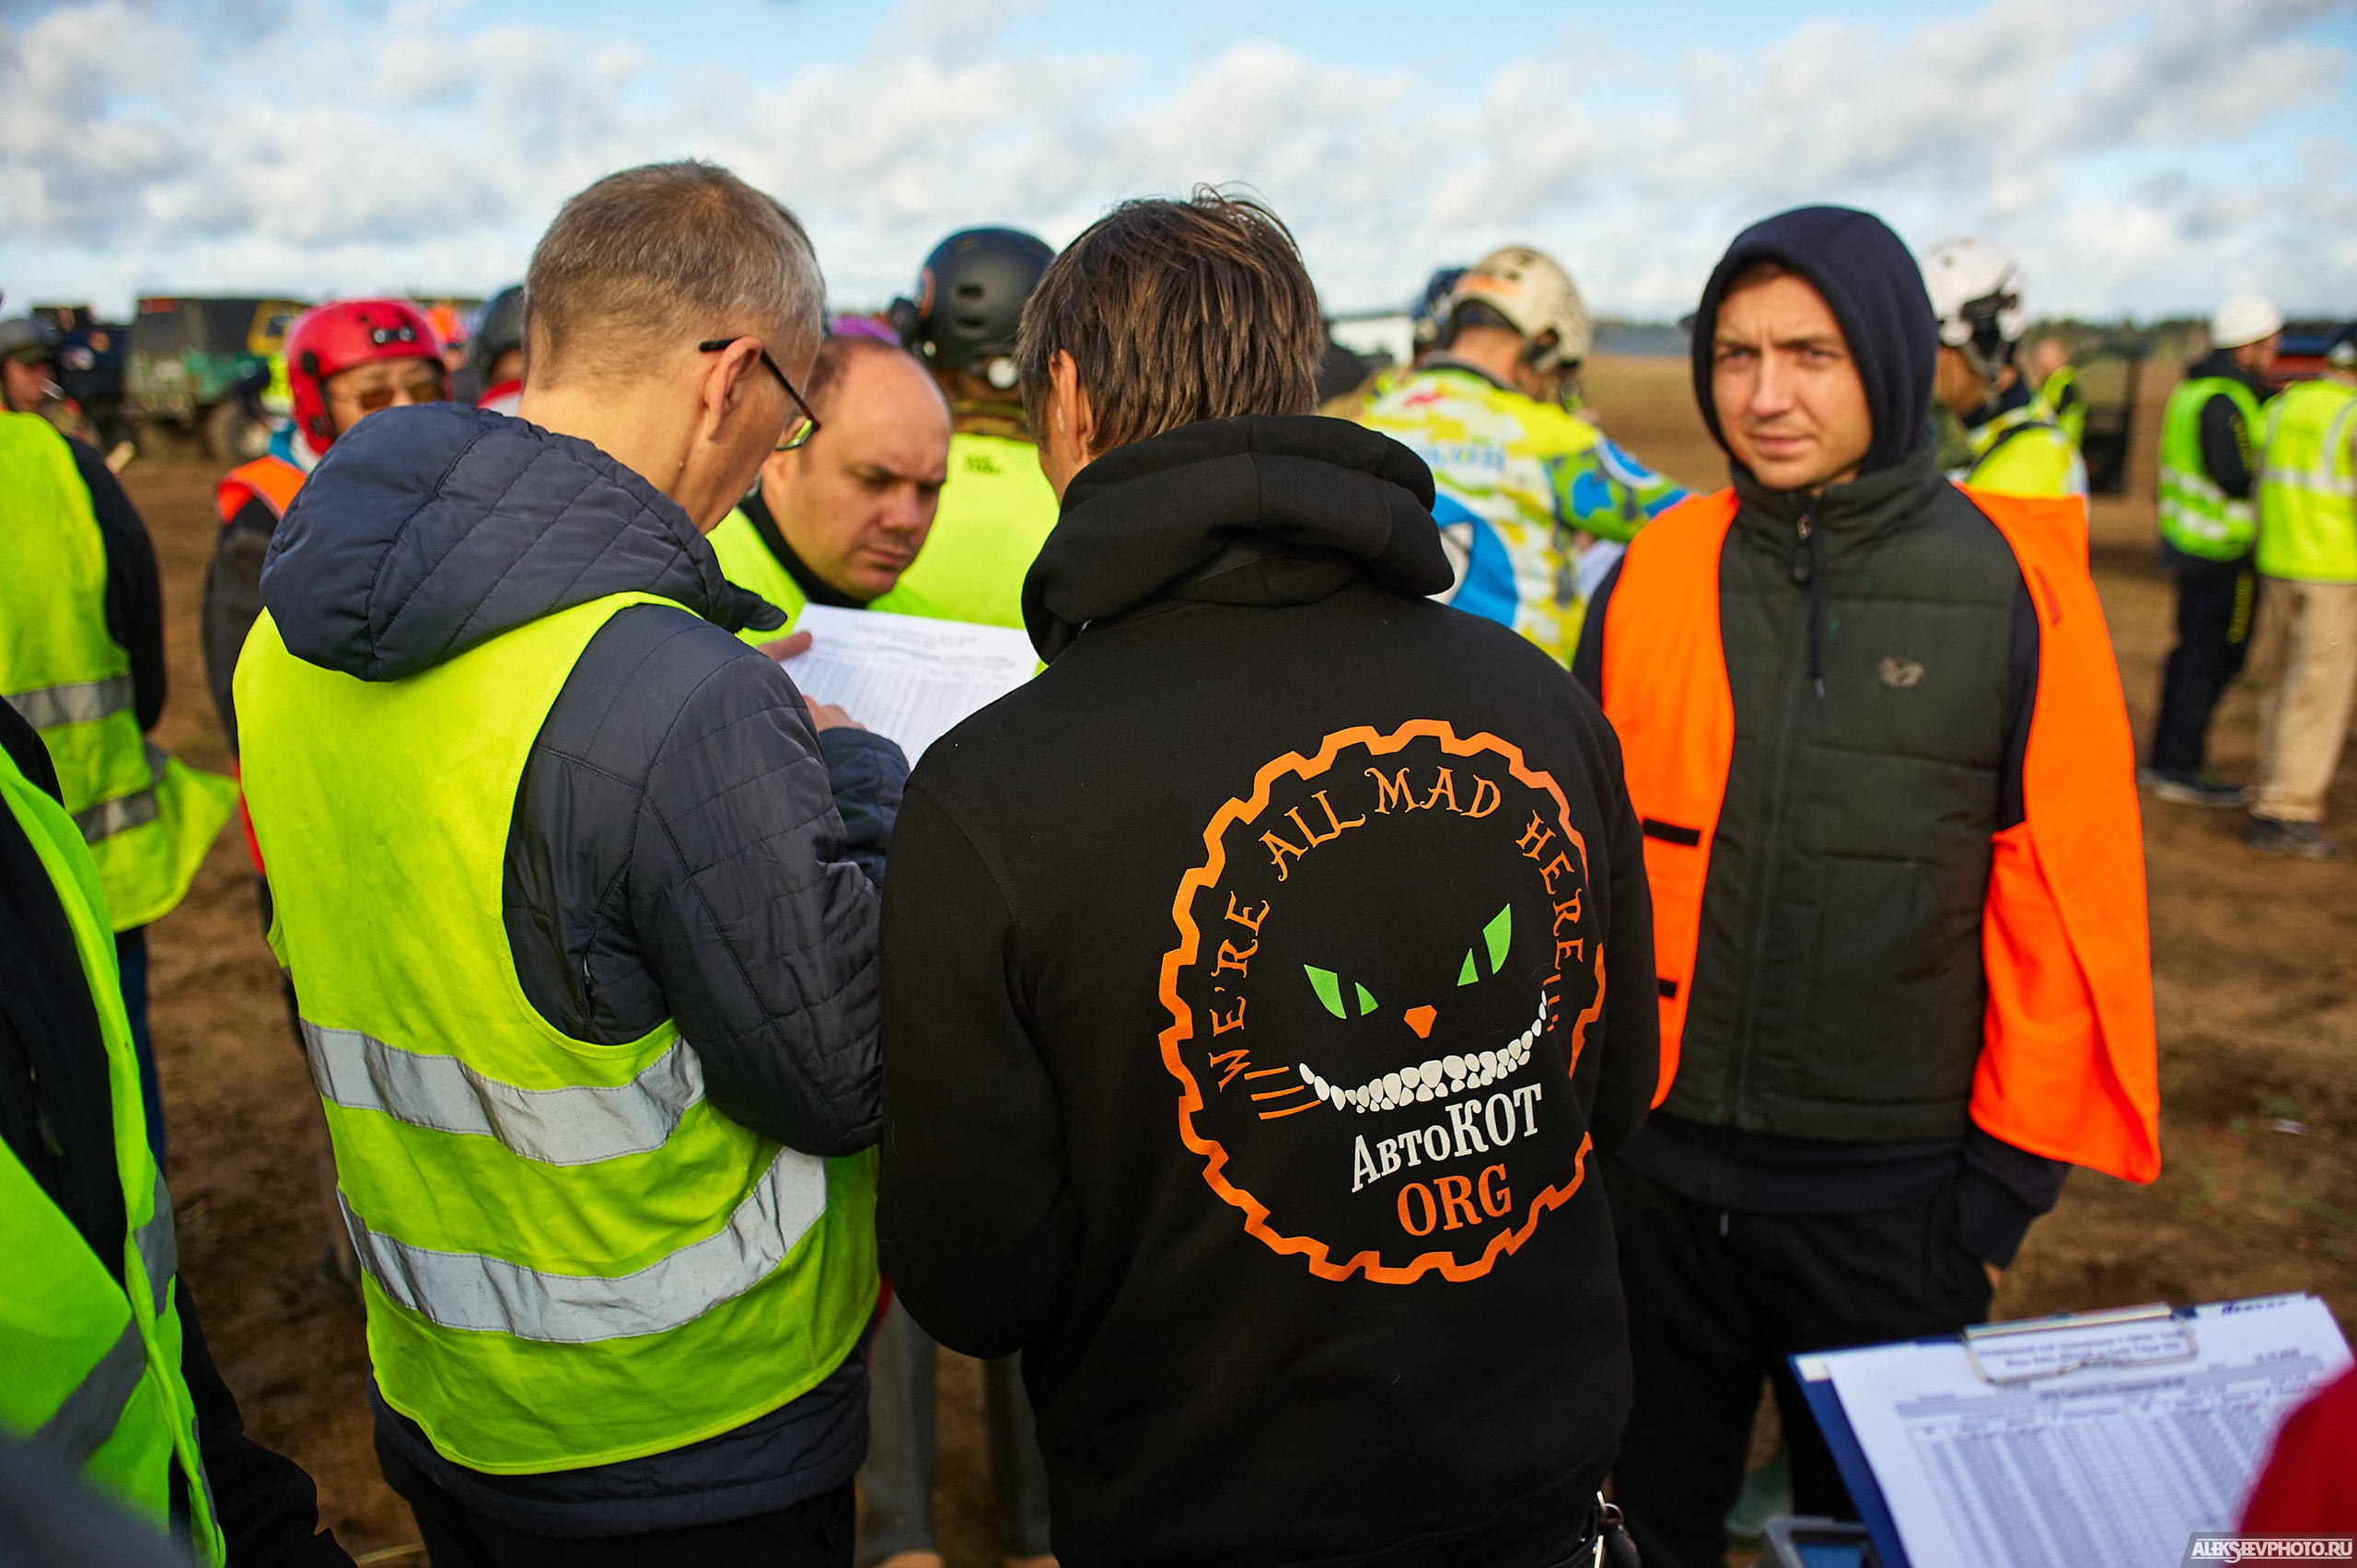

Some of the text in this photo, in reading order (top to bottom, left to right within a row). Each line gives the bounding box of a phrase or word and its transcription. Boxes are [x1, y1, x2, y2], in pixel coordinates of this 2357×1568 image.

[1208, 765, 1584, 1093] WE'RE ALL MAD HERE
[1397, 1163, 1513, 1237] ORG
